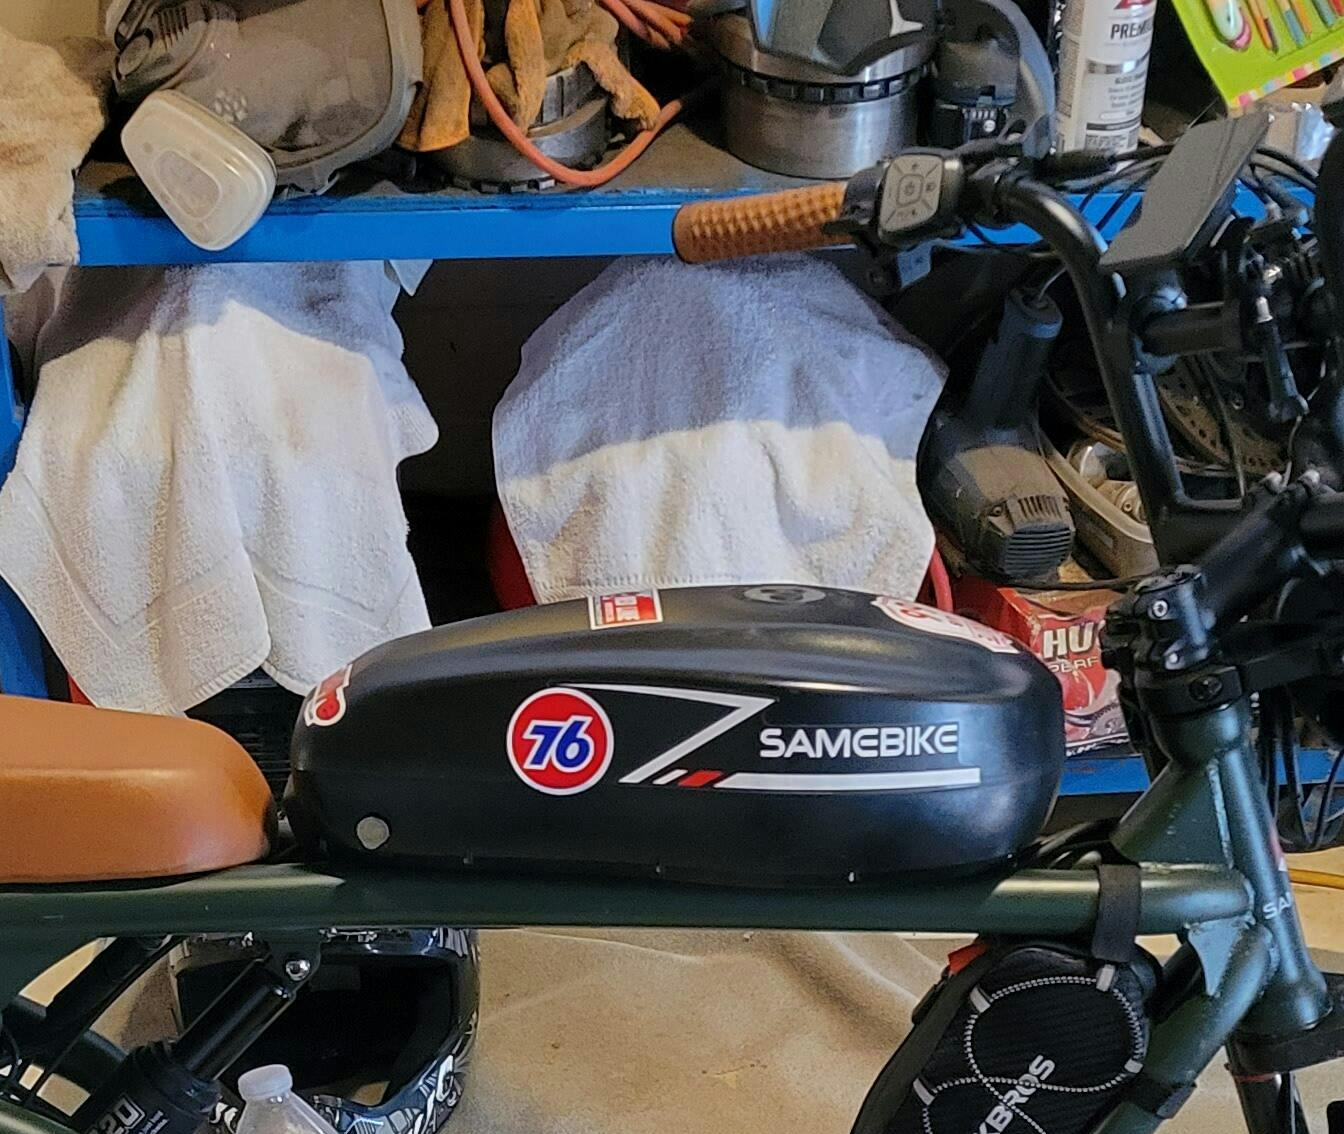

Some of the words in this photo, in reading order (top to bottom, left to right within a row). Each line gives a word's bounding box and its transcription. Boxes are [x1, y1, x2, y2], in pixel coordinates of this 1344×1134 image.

[1043, 619, 1106, 660] HU
[522, 714, 596, 773] 76
[759, 722, 959, 759] SAMEBIKE
